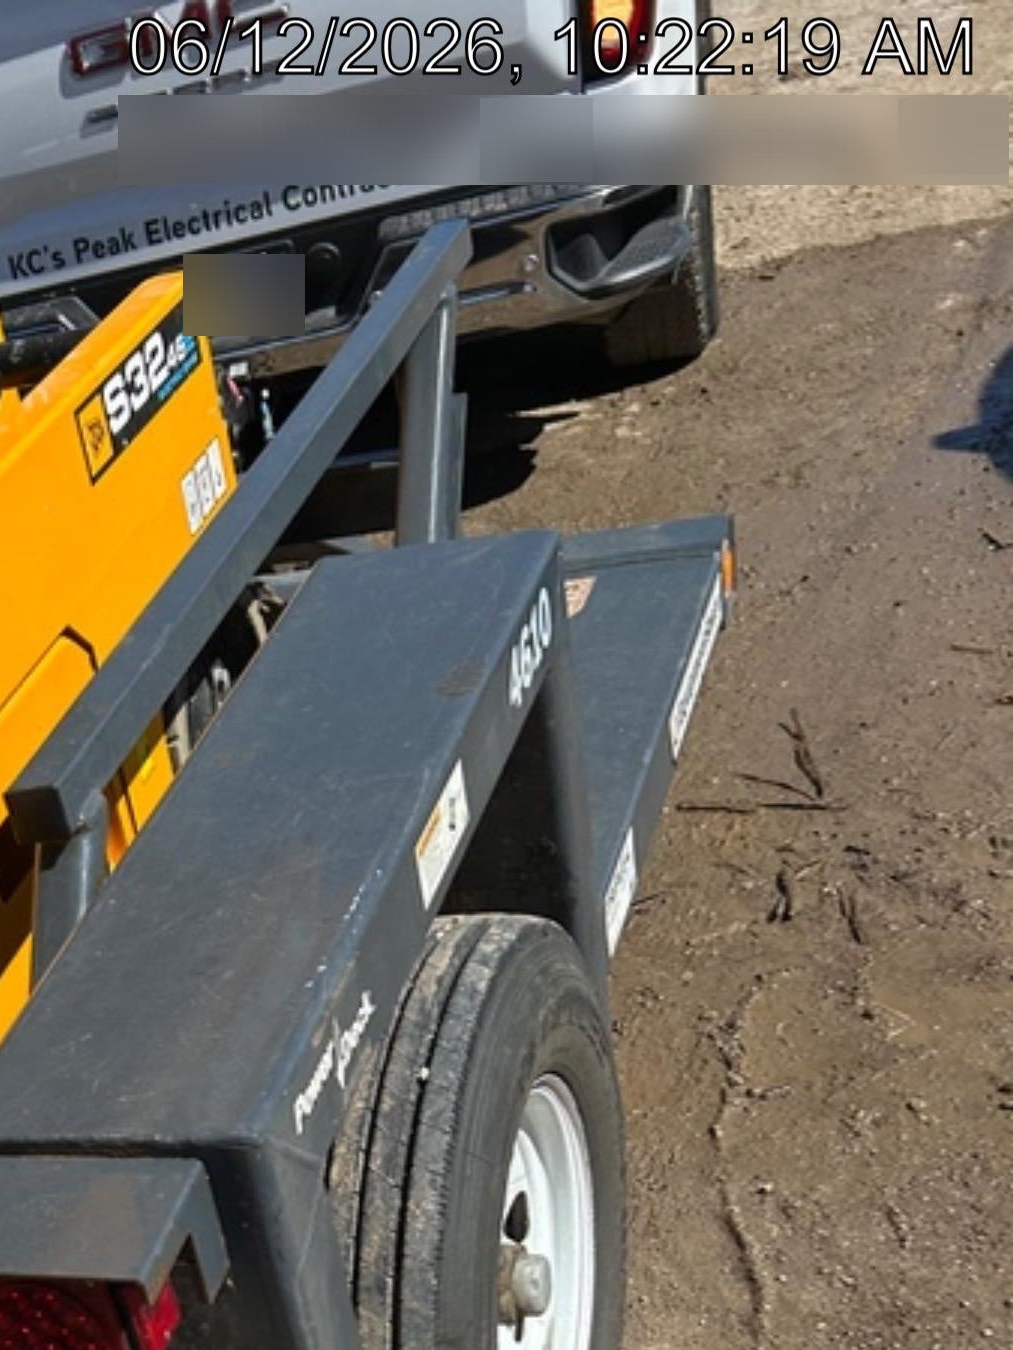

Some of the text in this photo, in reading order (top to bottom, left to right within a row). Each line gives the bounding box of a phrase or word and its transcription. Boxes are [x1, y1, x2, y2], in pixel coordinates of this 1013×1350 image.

[8, 243, 66, 280] KC's
[73, 227, 137, 265] Peak
[143, 190, 274, 247] Electrical
